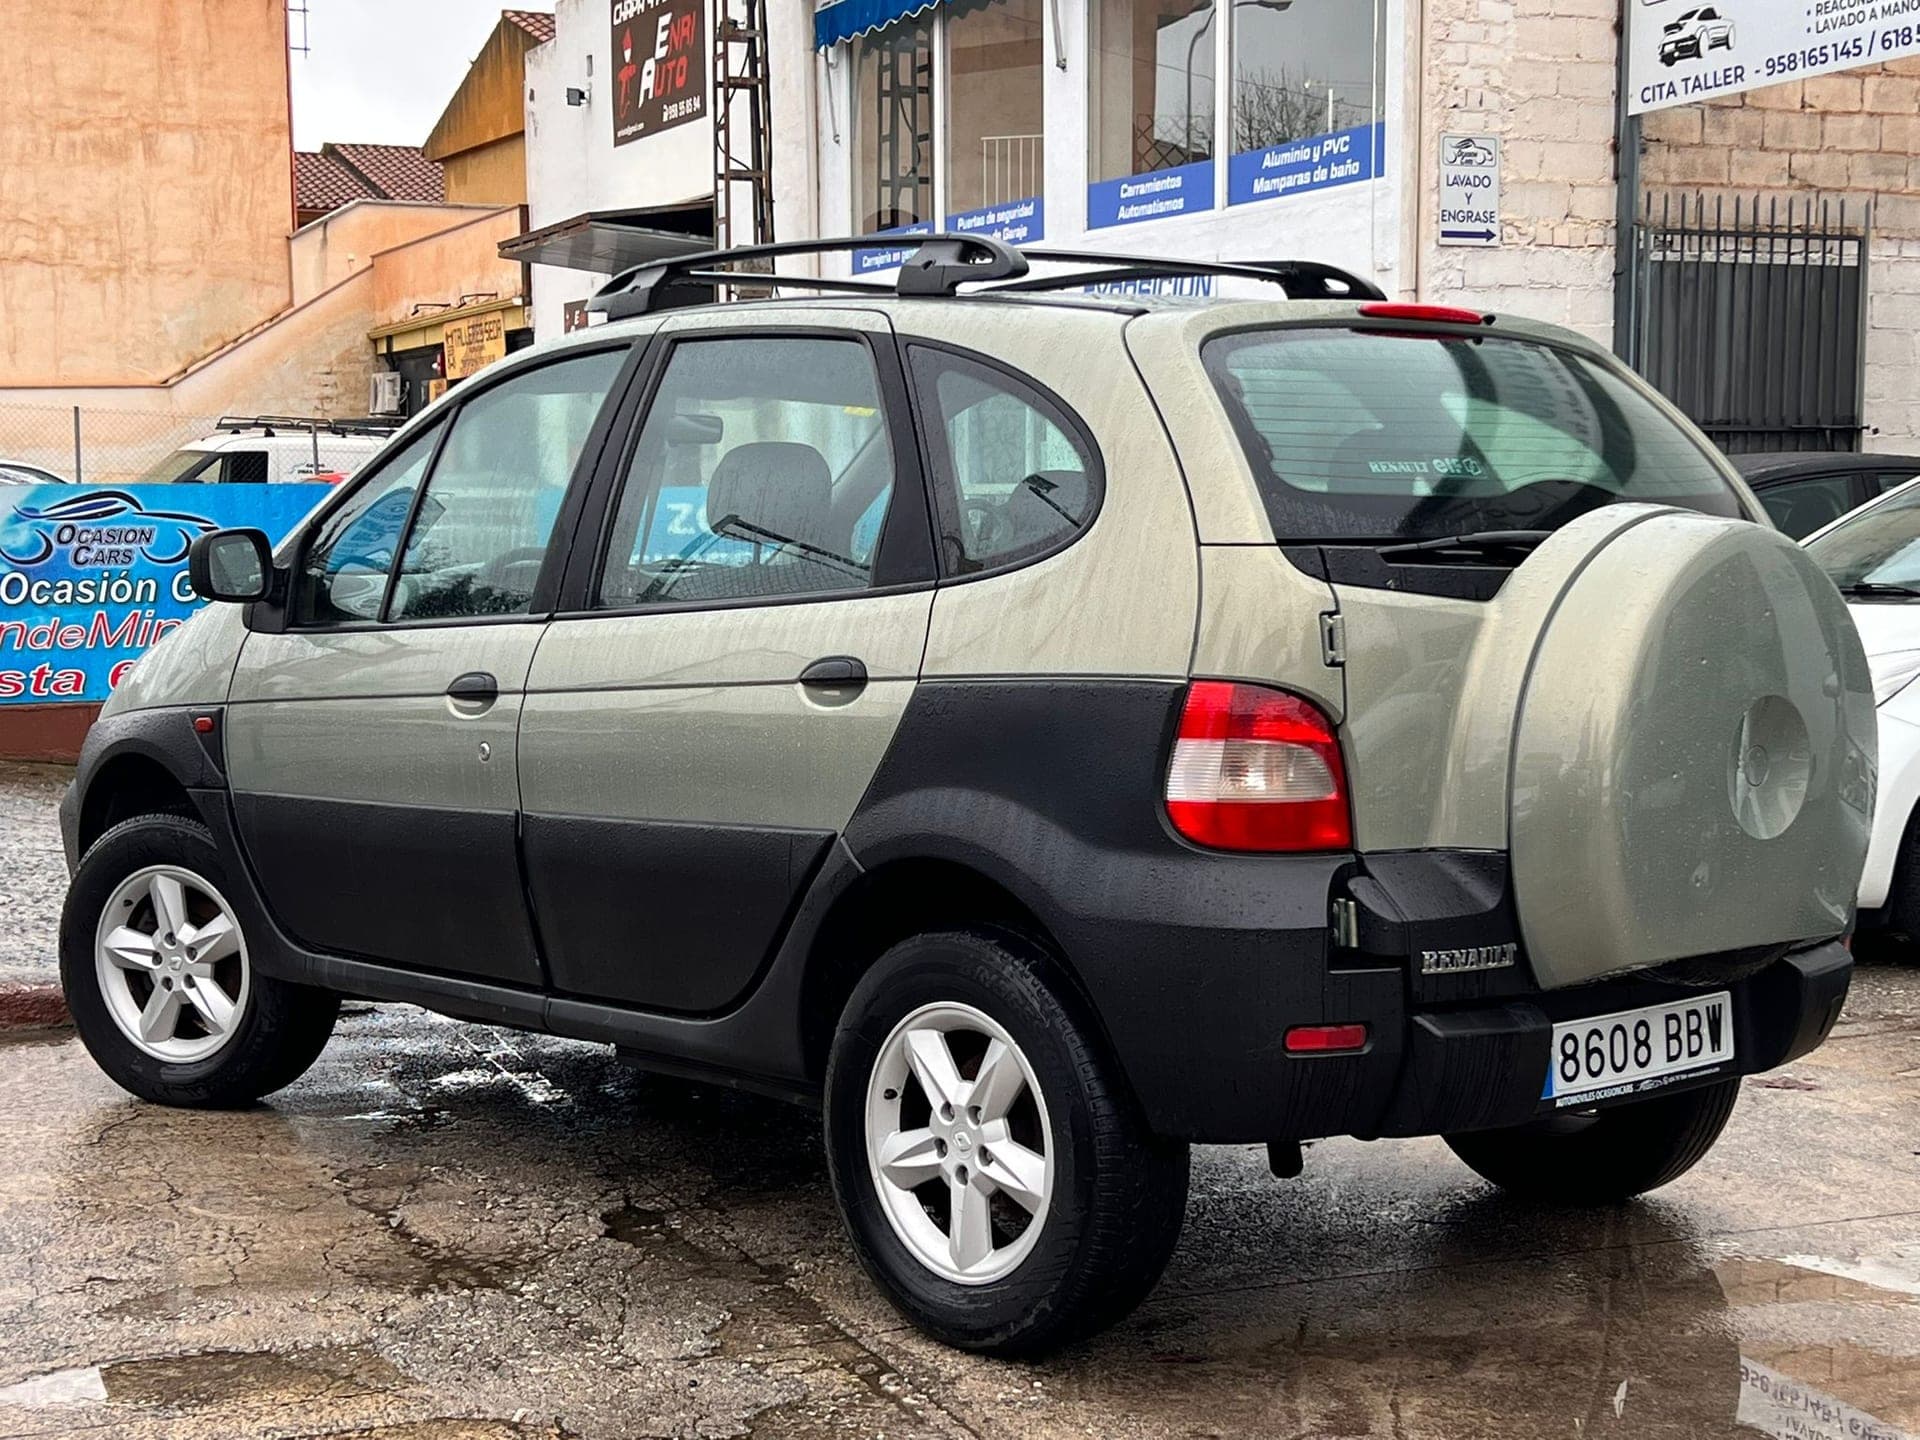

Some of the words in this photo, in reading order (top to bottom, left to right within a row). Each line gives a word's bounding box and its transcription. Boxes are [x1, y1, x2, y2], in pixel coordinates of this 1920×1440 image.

[1816, 10, 1866, 34] LAVADO
[1869, 7, 1878, 22] A
[655, 12, 696, 60] ENRI
[638, 56, 689, 109] AUTO
[1640, 82, 1677, 104] CITA
[1681, 65, 1745, 95] TALLER
[1262, 143, 1310, 171] Aluminio
[1312, 147, 1320, 163] y
[1322, 135, 1350, 157] PVC
[1119, 175, 1182, 199] Cerramientos
[1253, 169, 1310, 195] Mamparas
[1313, 164, 1328, 182] de
[1330, 159, 1360, 179] baño
[1446, 174, 1492, 189] LAVADO
[1117, 197, 1184, 221] Automatismos
[1464, 192, 1473, 206] Y
[957, 214, 985, 231] Puertas
[986, 211, 996, 225] de
[996, 201, 1035, 224] seguridad
[1440, 209, 1497, 224] ENGRASE
[1002, 224, 1028, 241] Garaje
[1369, 460, 1429, 473] RENAULT
[55, 523, 155, 546] OCASION
[71, 545, 133, 567] CARS
[0, 571, 157, 605] Ocasión
[1421, 943, 1517, 974] RENAULT
[1560, 1019, 1651, 1083] 8608
[1664, 1003, 1723, 1064] BBW
